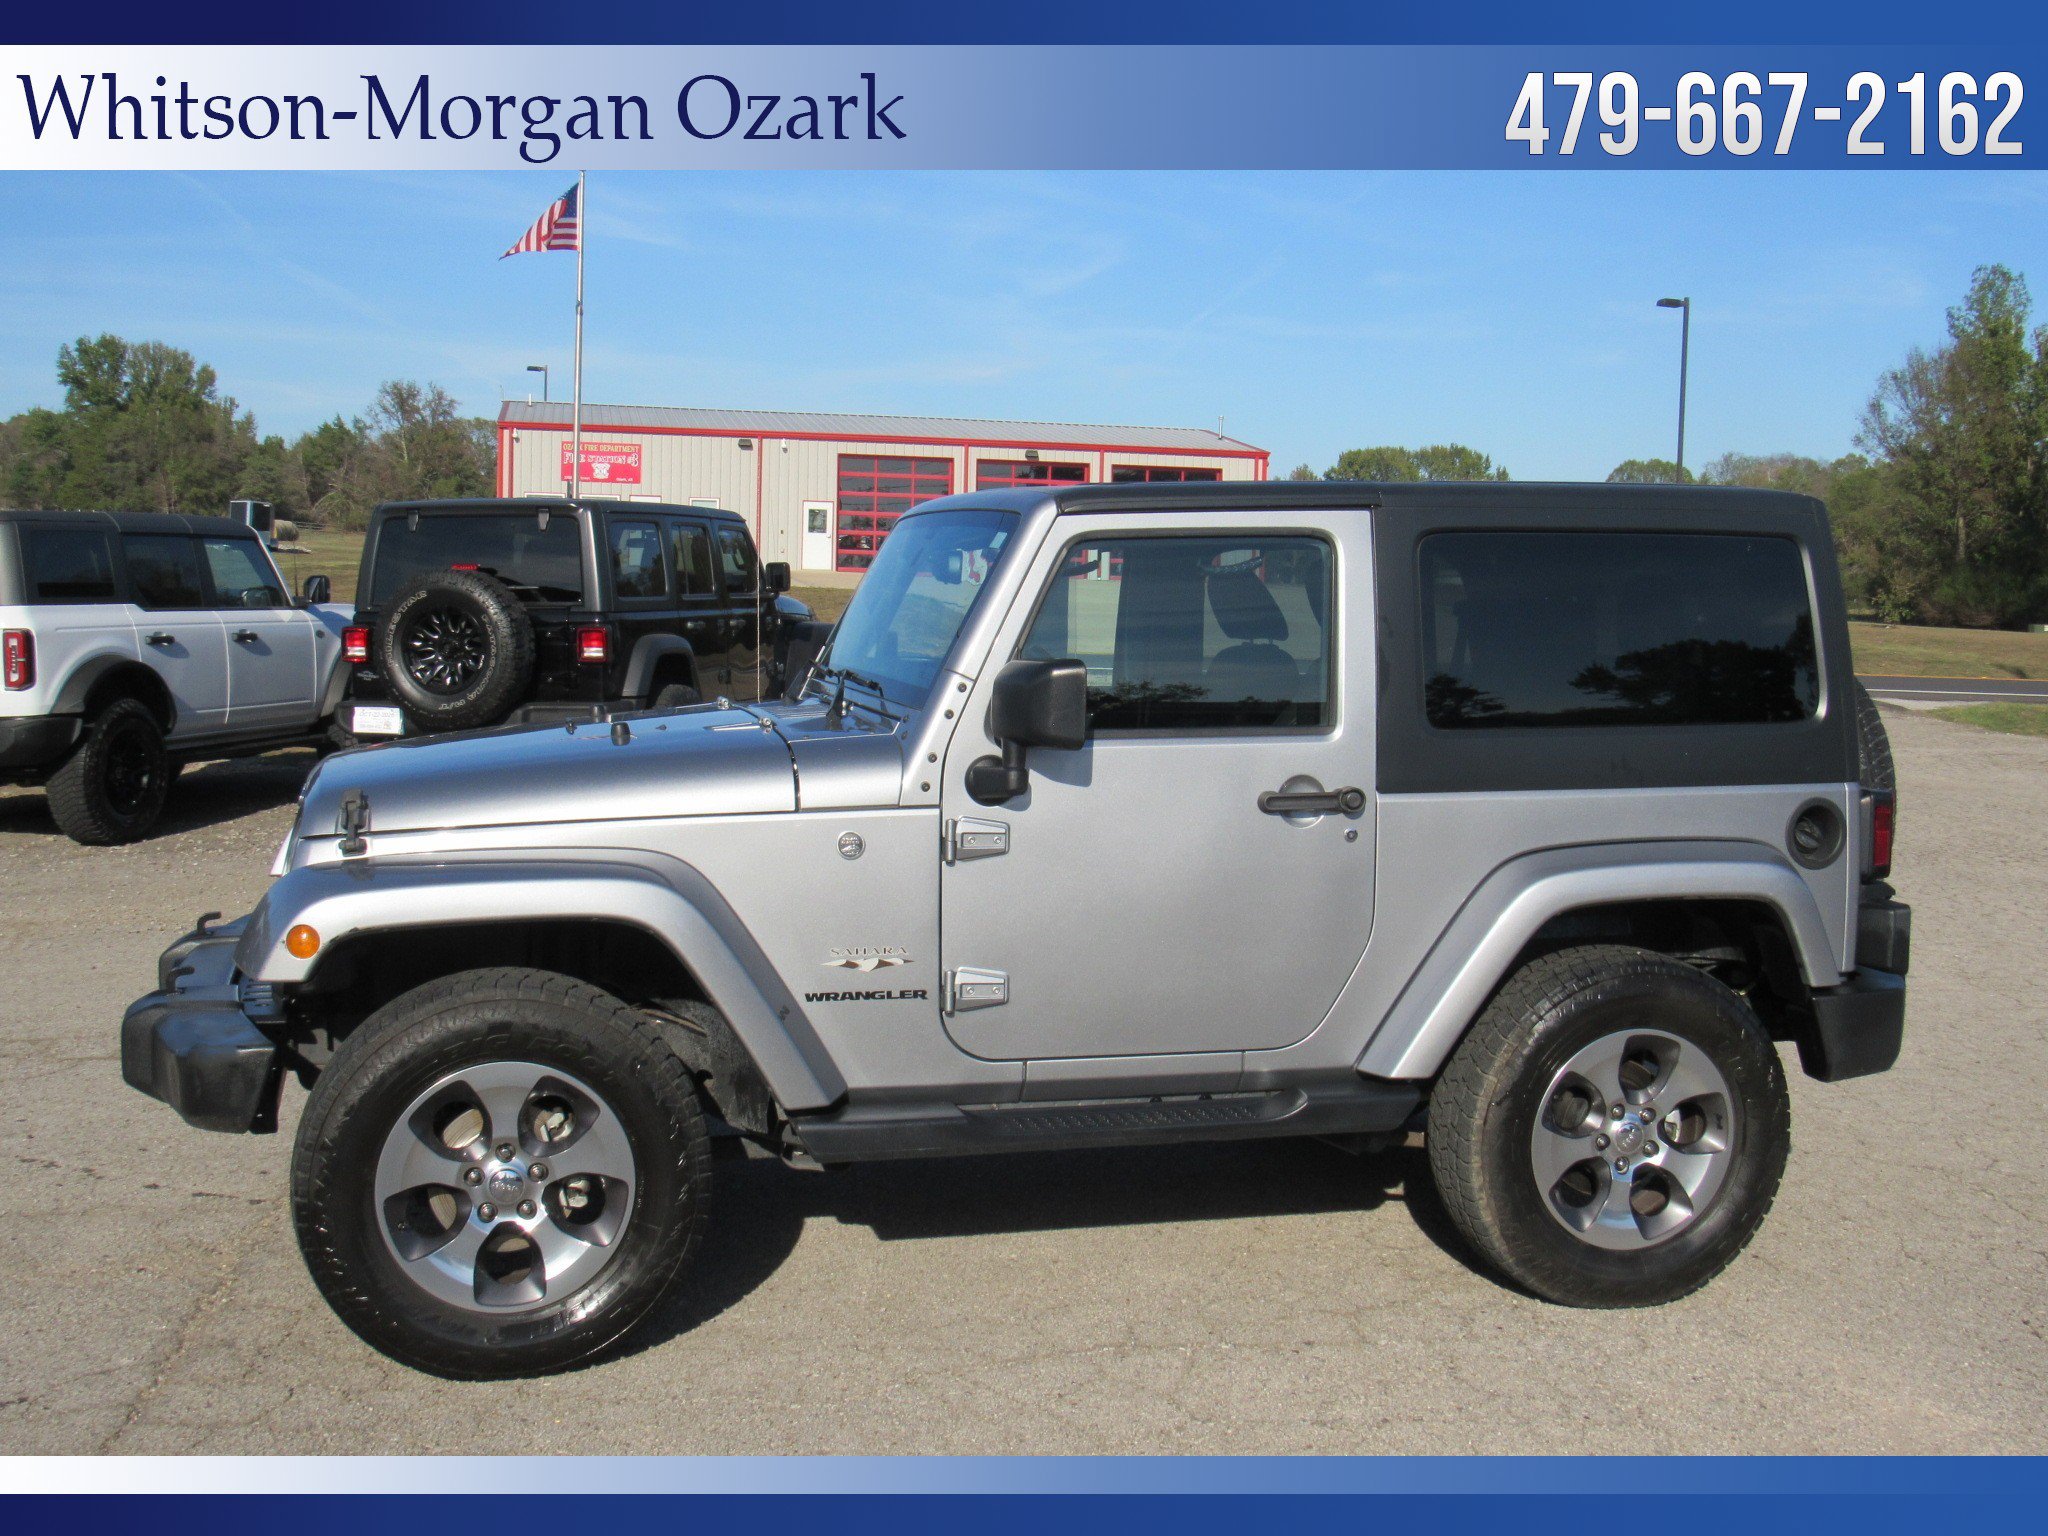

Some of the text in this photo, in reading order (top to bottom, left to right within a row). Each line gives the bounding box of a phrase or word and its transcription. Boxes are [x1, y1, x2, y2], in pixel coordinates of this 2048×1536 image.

[600, 445, 640, 453] DEPARTMENT
[563, 452, 586, 464] FIE
[830, 946, 908, 956] SAHARA
[804, 989, 928, 1003] WRANGLER
